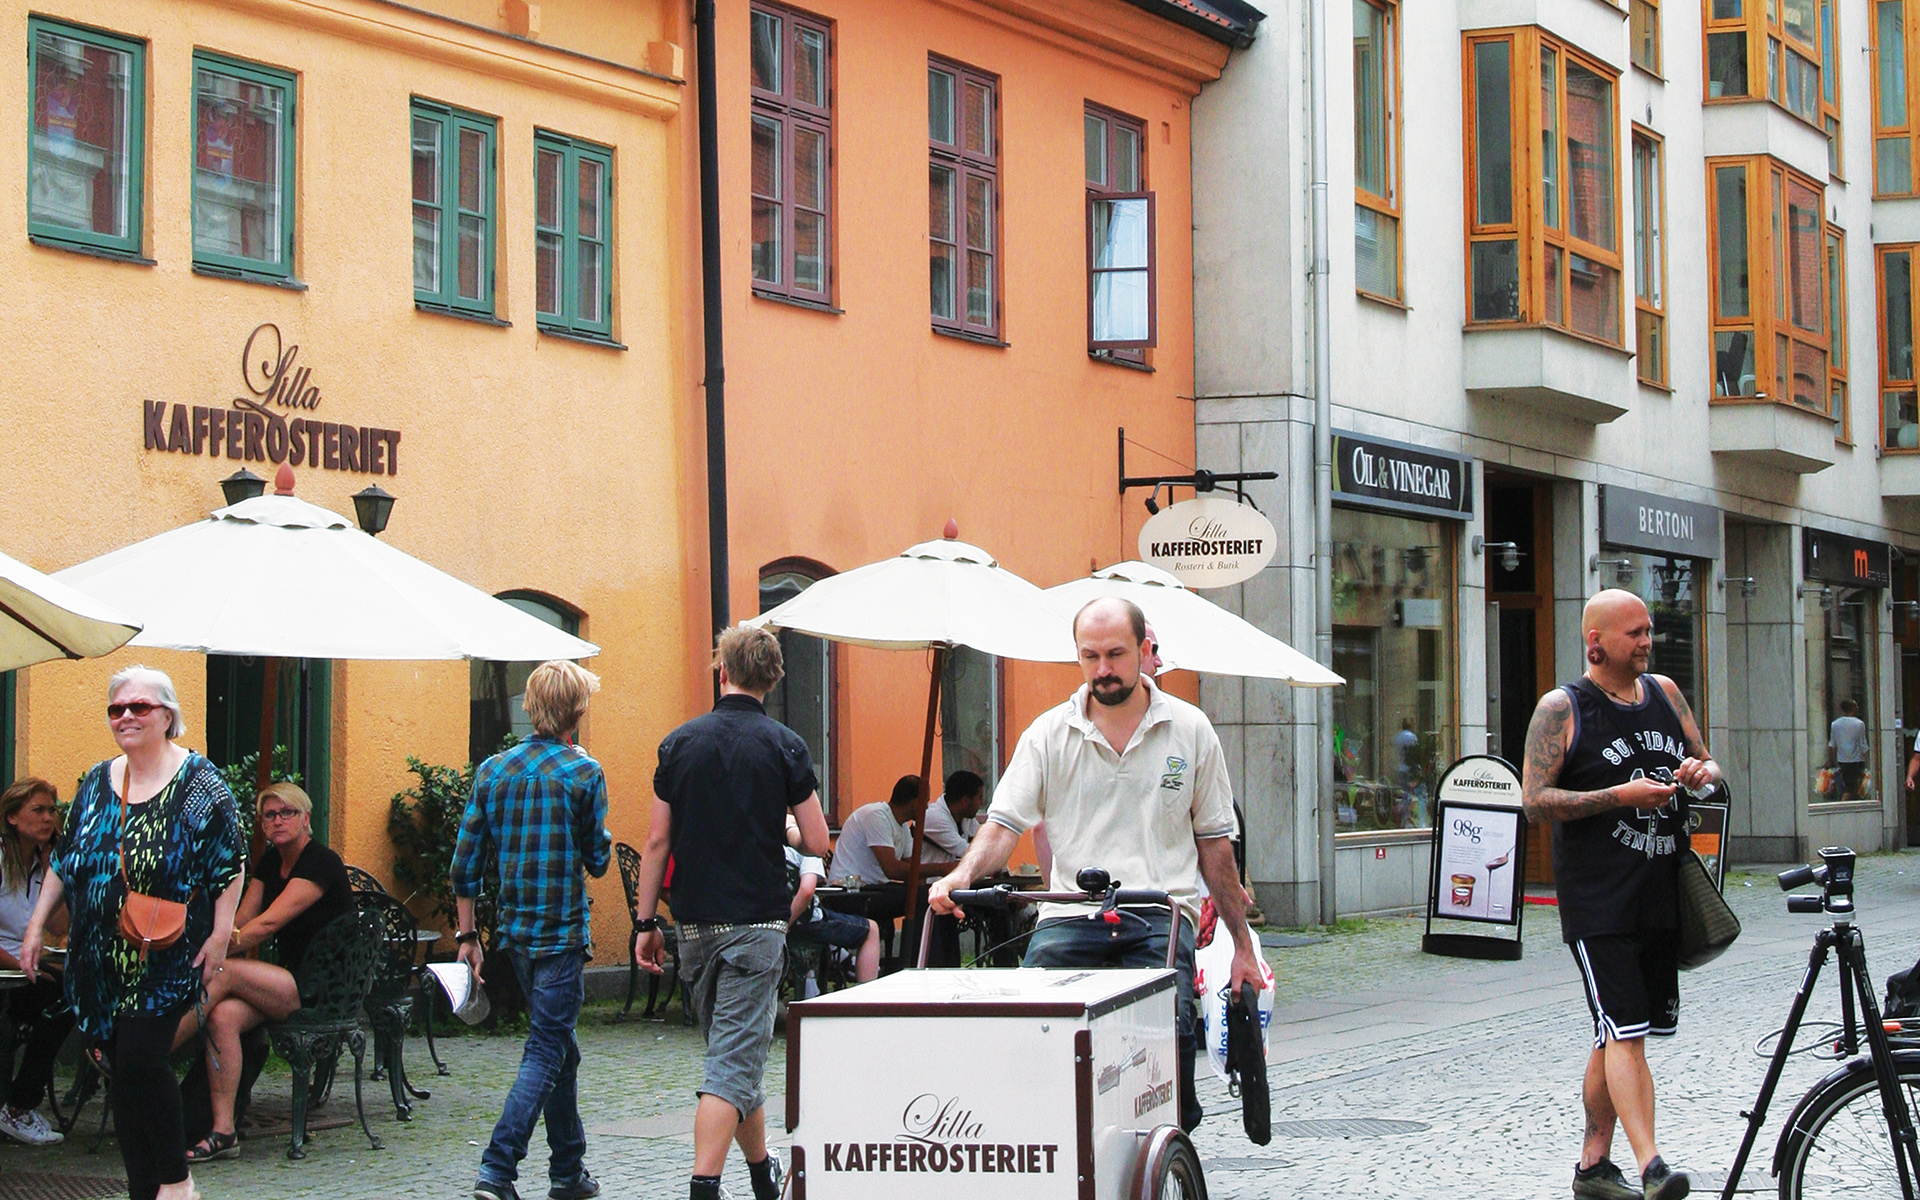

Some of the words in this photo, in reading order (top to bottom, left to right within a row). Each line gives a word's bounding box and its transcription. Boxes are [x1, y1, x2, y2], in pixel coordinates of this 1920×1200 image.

[233, 323, 322, 419] Lilla
[143, 398, 401, 476] KAFFEROSTERIET
[1352, 446, 1378, 488] OIL
[1378, 456, 1389, 490] &
[1389, 458, 1452, 500] VINEGAR
[1185, 516, 1228, 542] Lilla
[1639, 505, 1694, 541] BERTONI
[1151, 539, 1263, 558] KAFFEROSTERIET
[1174, 561, 1205, 571] Rosteri
[1206, 560, 1214, 570] &
[1217, 560, 1240, 570] Butik
[1453, 778, 1512, 791] KAFFEROSTERIET
[1453, 818, 1483, 845] 98g
[894, 1092, 986, 1146] Lilla
[823, 1142, 1059, 1174] KAFFEROSTERIET
